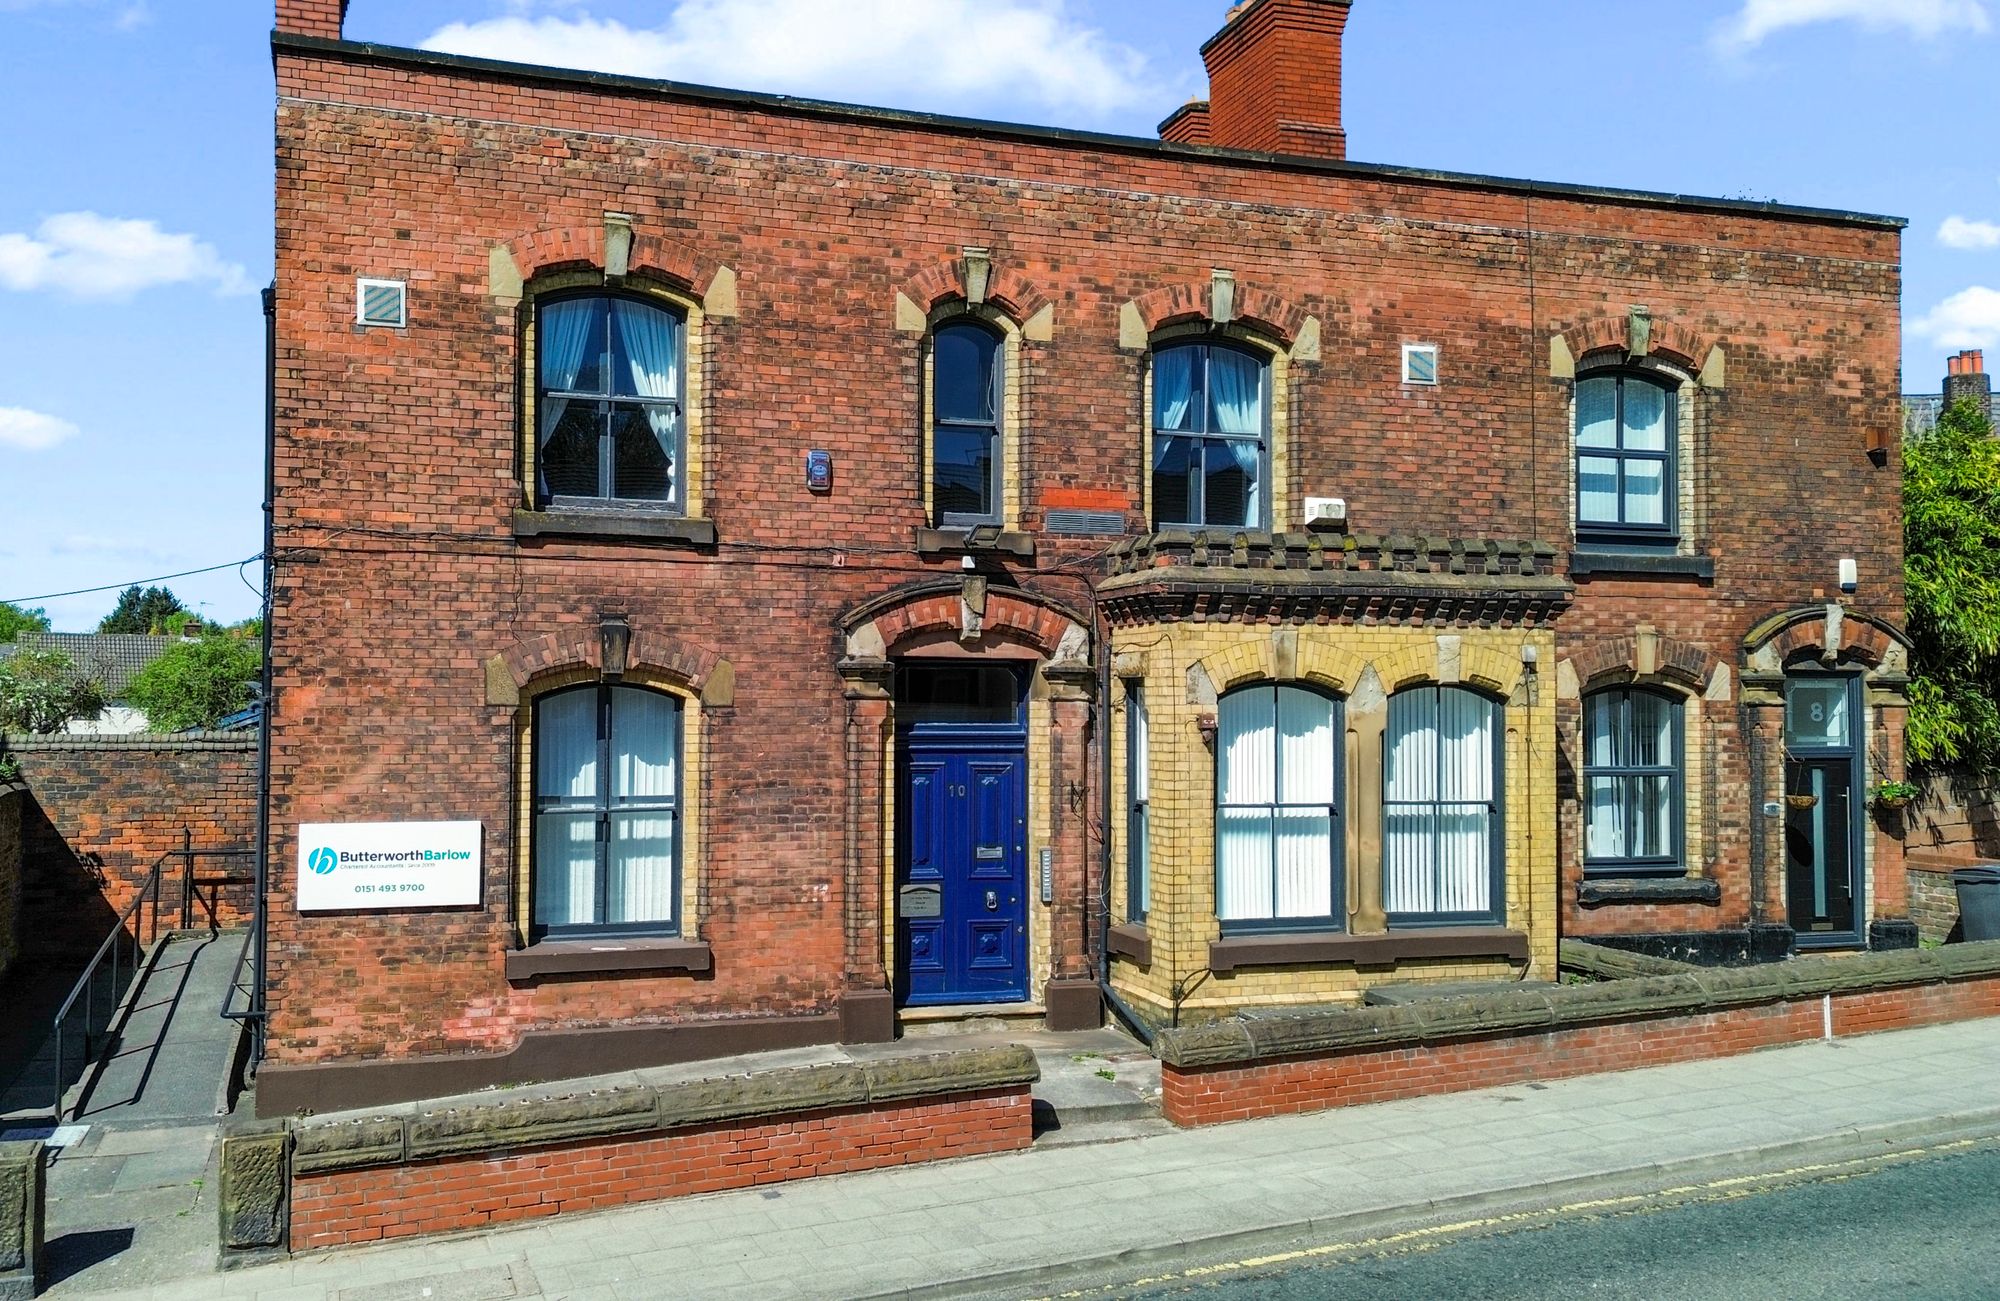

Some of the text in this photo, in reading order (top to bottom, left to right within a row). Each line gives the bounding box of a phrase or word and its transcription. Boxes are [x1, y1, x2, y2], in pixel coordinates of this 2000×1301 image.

[1810, 702, 1823, 722] 8
[949, 785, 965, 797] 10
[340, 850, 471, 862] ButterworthBarlow
[354, 883, 425, 893] 0151 493 9700
